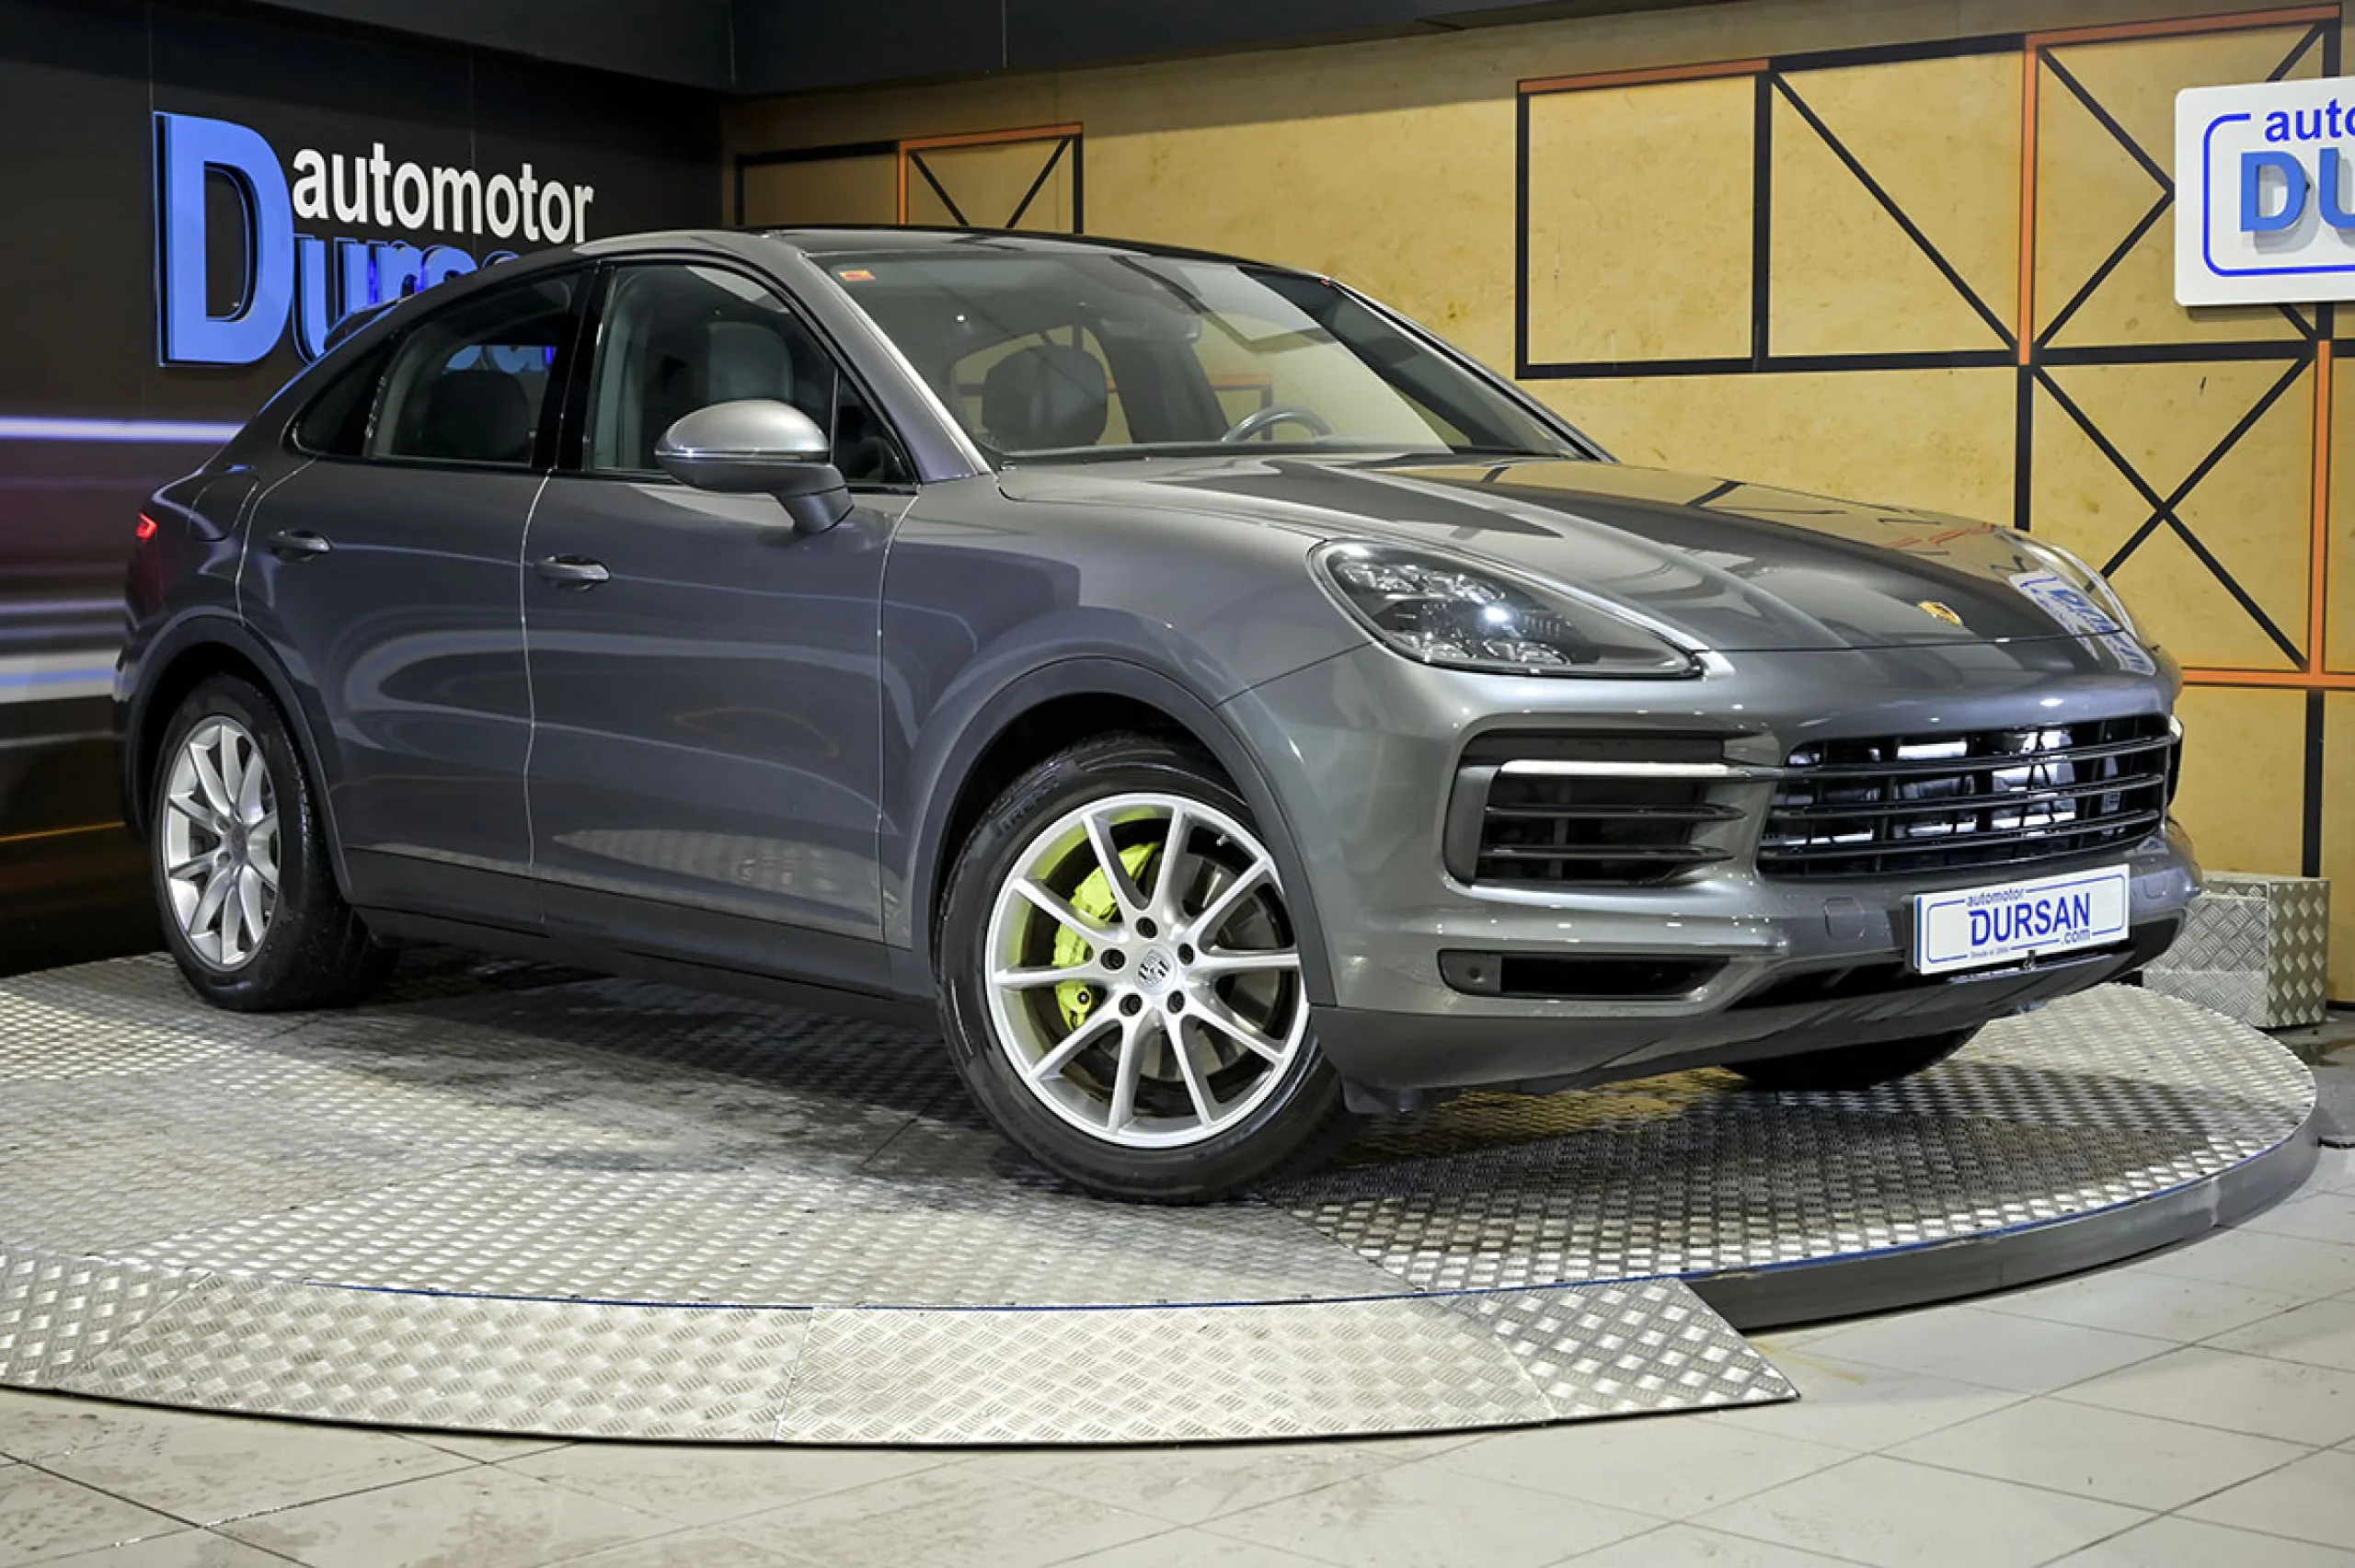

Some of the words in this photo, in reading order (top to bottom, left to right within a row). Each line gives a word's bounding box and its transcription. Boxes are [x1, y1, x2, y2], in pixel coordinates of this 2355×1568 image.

[293, 143, 594, 244] automotor
[1967, 888, 2025, 908] automotor
[1968, 892, 2091, 946] DURSAN
